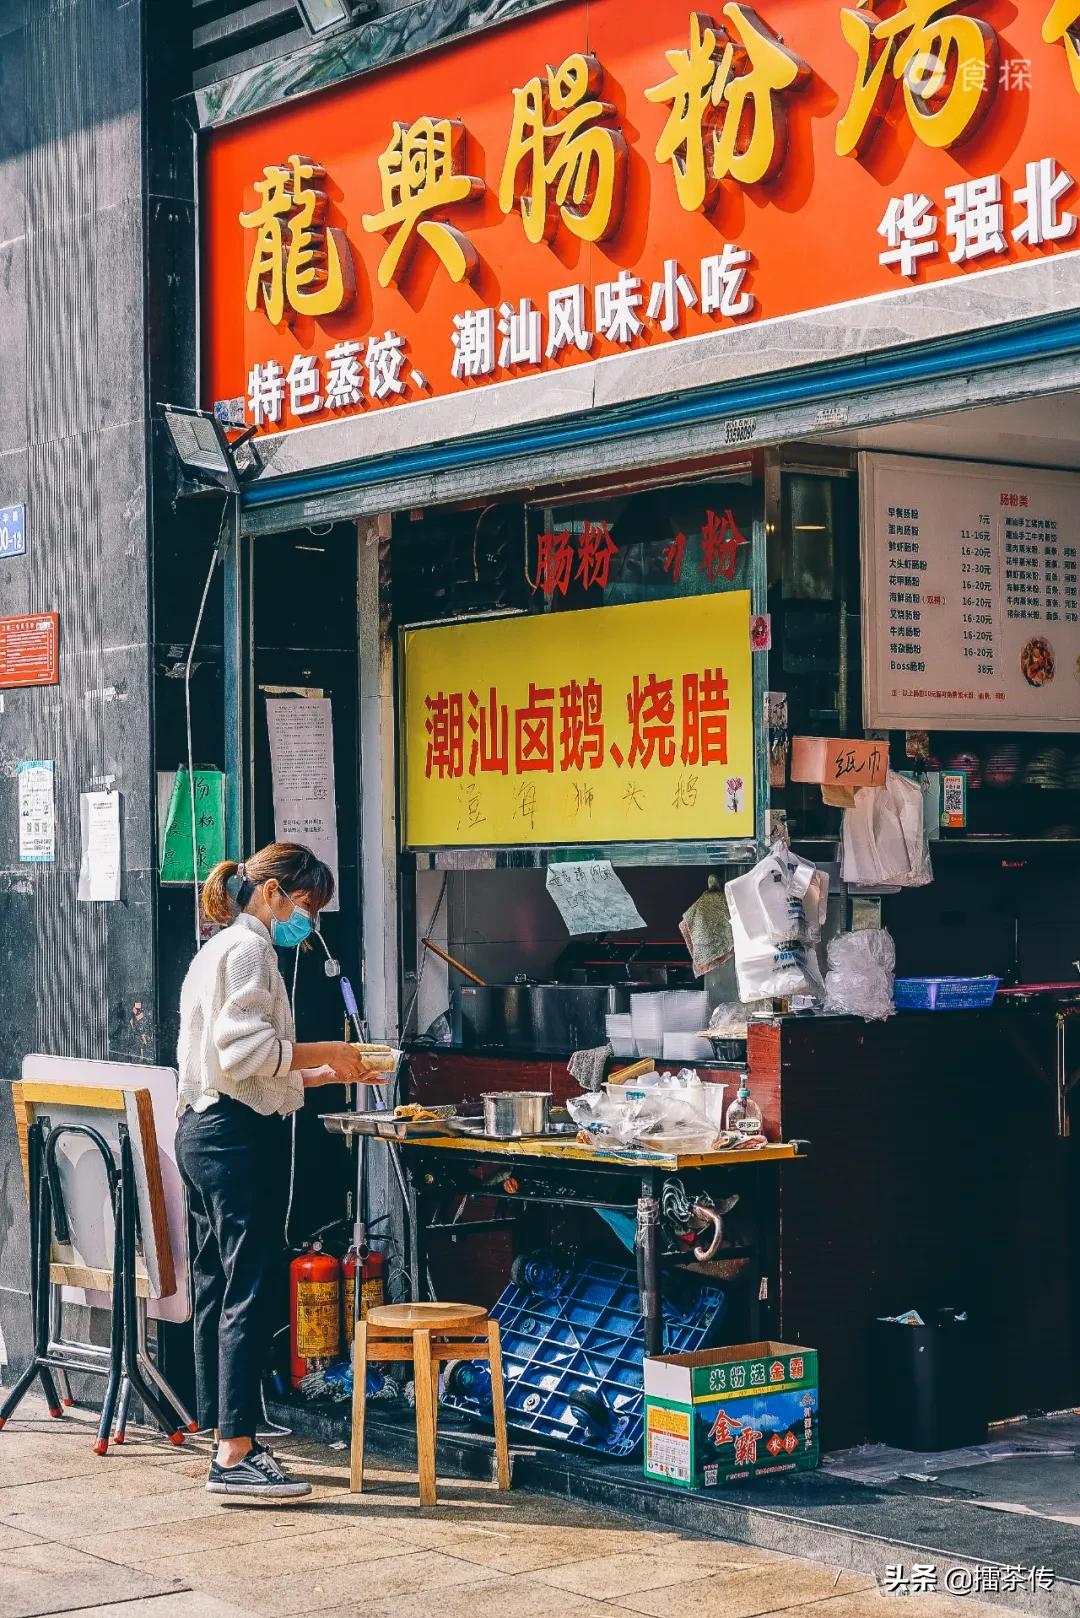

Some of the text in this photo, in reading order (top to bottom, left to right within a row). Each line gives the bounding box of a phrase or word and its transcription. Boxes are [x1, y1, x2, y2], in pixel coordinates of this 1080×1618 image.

[876, 156, 1077, 277] 华强北
[451, 243, 756, 380] 潮汕风味小吃
[535, 519, 619, 595] 肠粉
[961, 547, 991, 558] 16-20元
[961, 564, 991, 575] 22-30元
[962, 581, 992, 591] 16-20元
[962, 597, 992, 608] 16-20元
[963, 614, 992, 624] 16-20元
[890, 626, 993, 641] 牛肉肠粉 16-20元
[964, 647, 993, 658] 16-20元
[977, 665, 994, 675] 38元
[424, 668, 730, 780] 潮汕卤鹅、烧腊
[835, 747, 881, 784] 纸巾
[710, 1357, 804, 1391] 米粉选金霸
[707, 1409, 763, 1466] 金霸
[768, 1434, 797, 1452] 米粉
